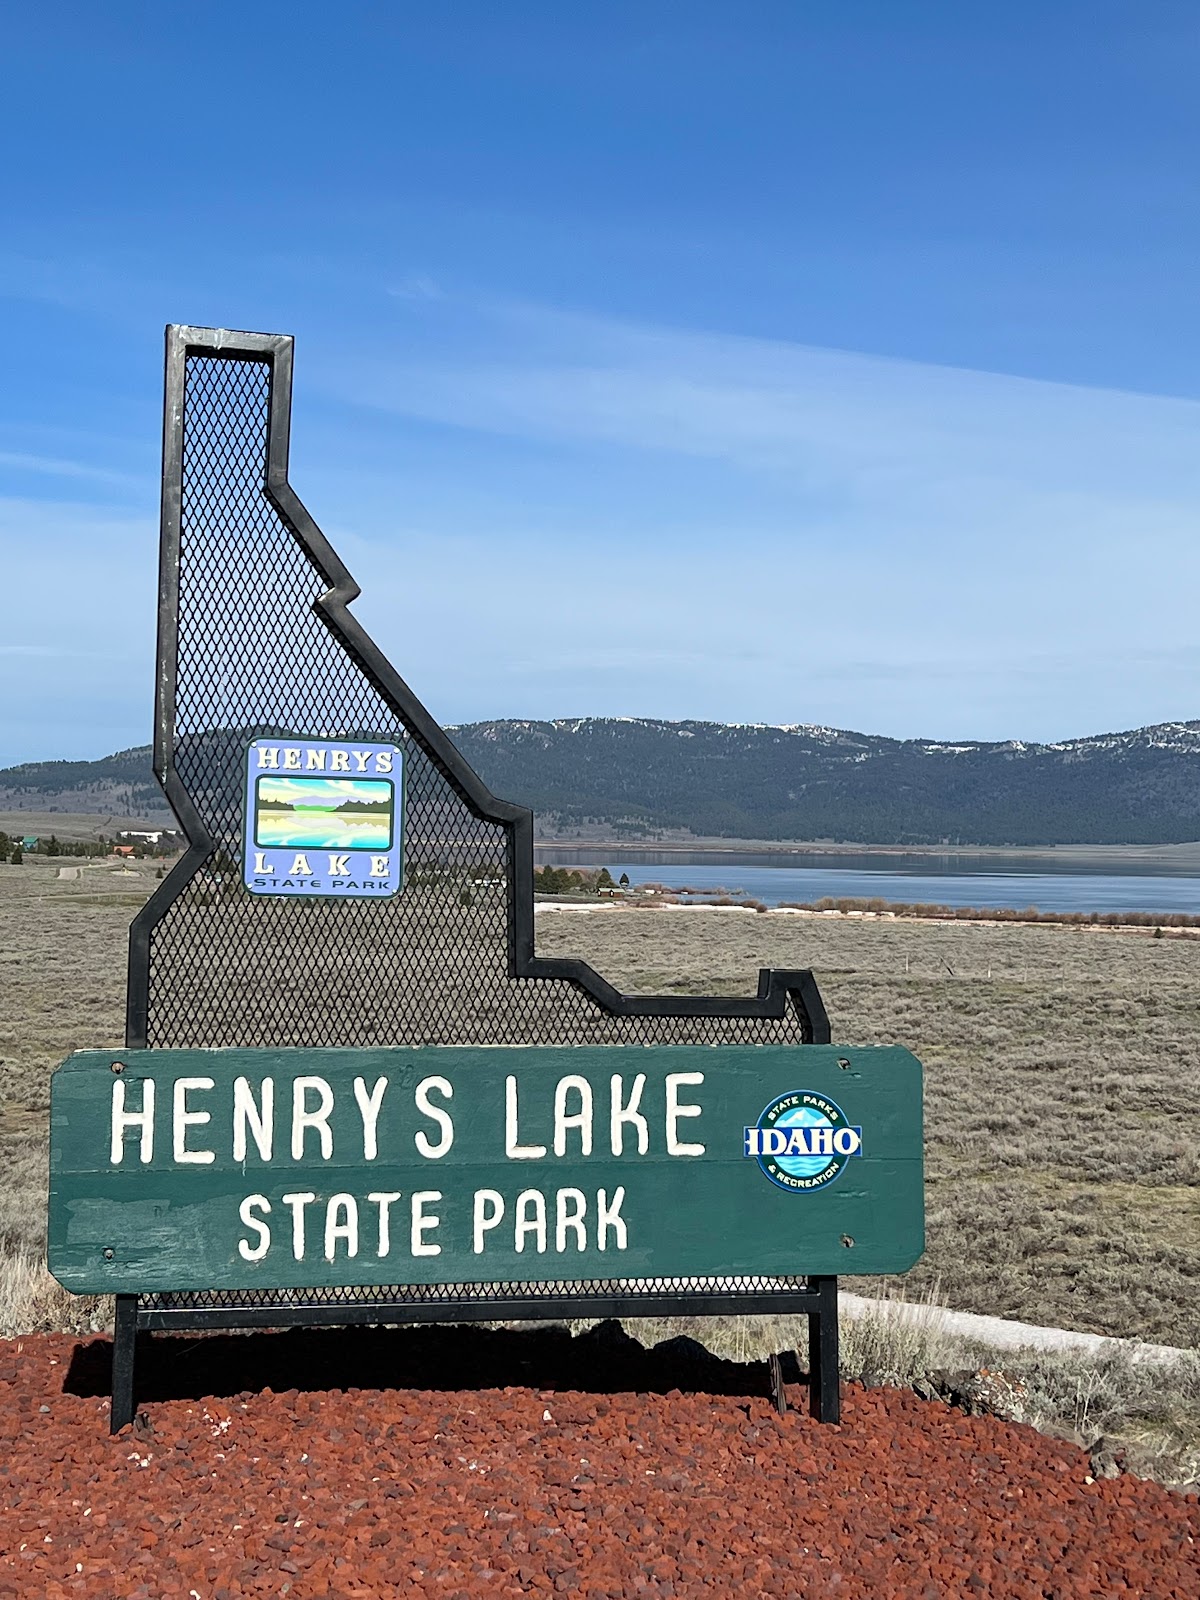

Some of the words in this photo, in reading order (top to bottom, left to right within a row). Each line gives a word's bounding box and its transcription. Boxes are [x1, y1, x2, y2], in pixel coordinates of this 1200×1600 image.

[257, 747, 393, 773] HENRYS
[254, 852, 391, 877] LAKE
[254, 878, 321, 888] STATE
[332, 880, 390, 889] PARK
[110, 1075, 454, 1164] HENRYS
[505, 1071, 706, 1159] LAKE
[767, 1096, 799, 1121] STATE
[803, 1095, 839, 1121] PARKS
[746, 1128, 860, 1155] IDAHO
[767, 1164, 777, 1174] &
[776, 1162, 840, 1188] RECREATION
[238, 1190, 442, 1261] STATE
[473, 1186, 628, 1254] PARK
